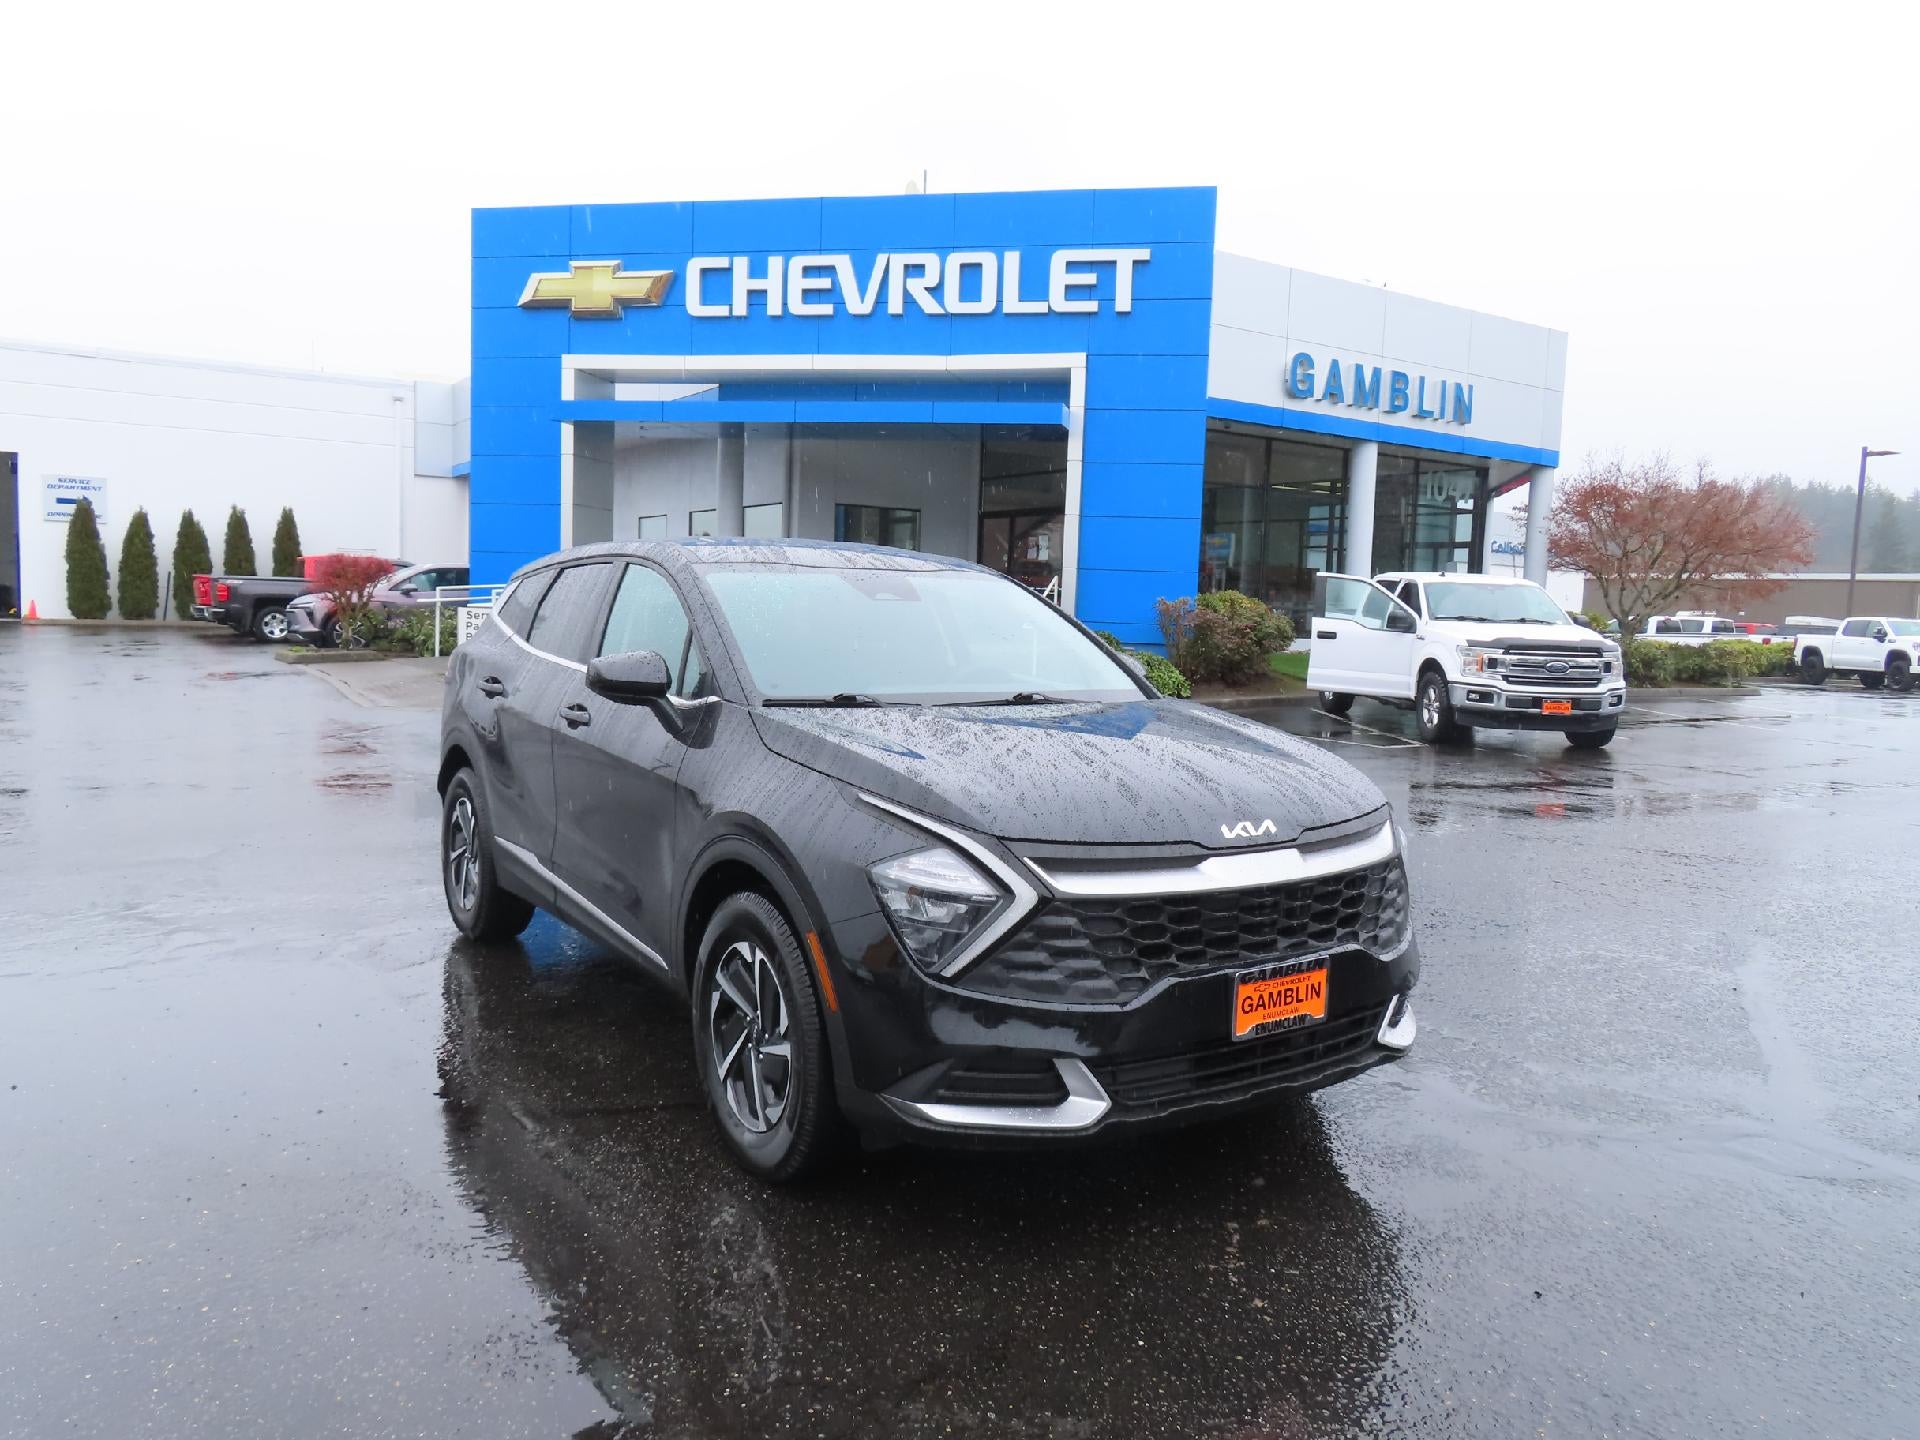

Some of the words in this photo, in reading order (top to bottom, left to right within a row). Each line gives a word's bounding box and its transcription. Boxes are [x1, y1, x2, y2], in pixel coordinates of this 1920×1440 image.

[686, 249, 1150, 316] CHEVROLET
[1286, 352, 1474, 425] GAMBLIN
[1490, 540, 1525, 555] Collisio
[466, 611, 489, 620] Ser
[466, 622, 480, 631] Pa
[1221, 819, 1277, 838] KIA
[1272, 976, 1312, 989] CHEVROLET
[1241, 981, 1322, 1015] GAMBLIN
[1262, 1006, 1300, 1020] ENUMCLAW
[1255, 1014, 1307, 1035] ENUMCLAW
